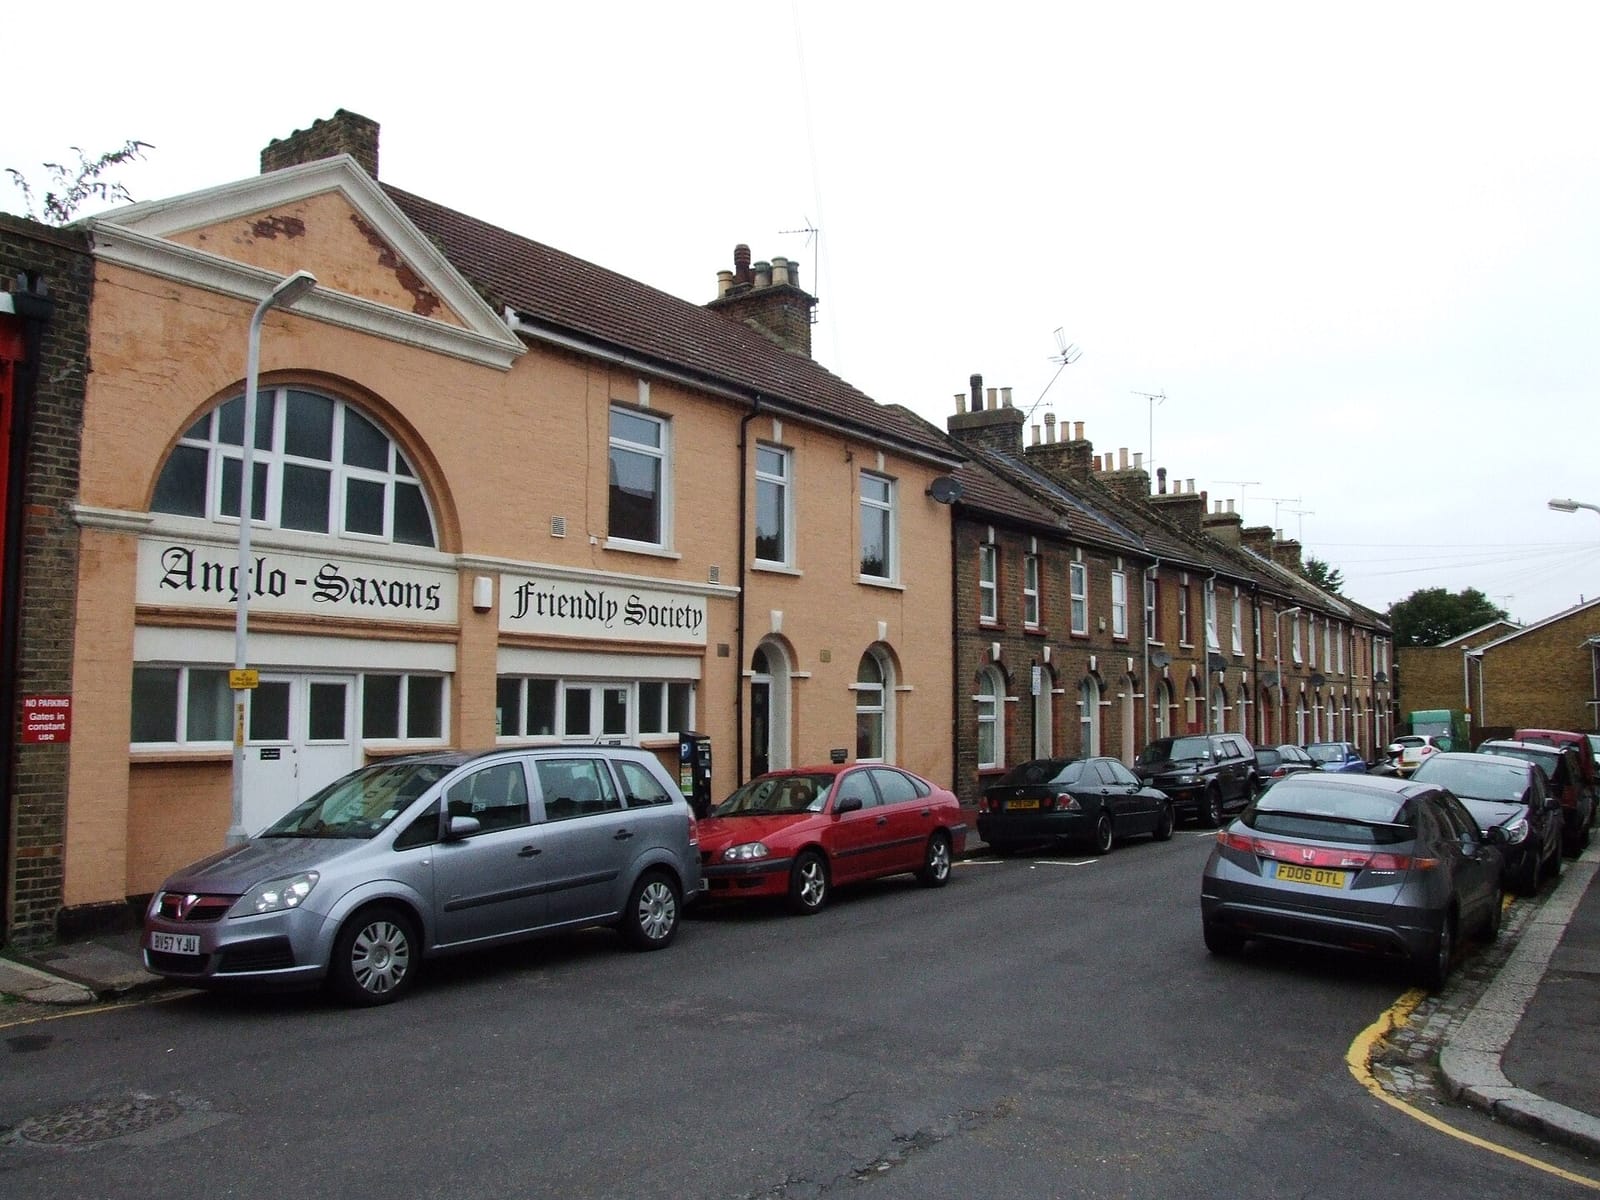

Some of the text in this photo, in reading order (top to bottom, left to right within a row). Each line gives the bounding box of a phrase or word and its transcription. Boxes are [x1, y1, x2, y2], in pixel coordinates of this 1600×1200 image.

[510, 580, 702, 636] Friendly Society
[25, 699, 69, 707] NO PARKING
[29, 712, 65, 721] Gates in
[27, 722, 66, 731] constant
[1278, 865, 1341, 885] FD06 OTL
[176, 938, 195, 952] YJU
